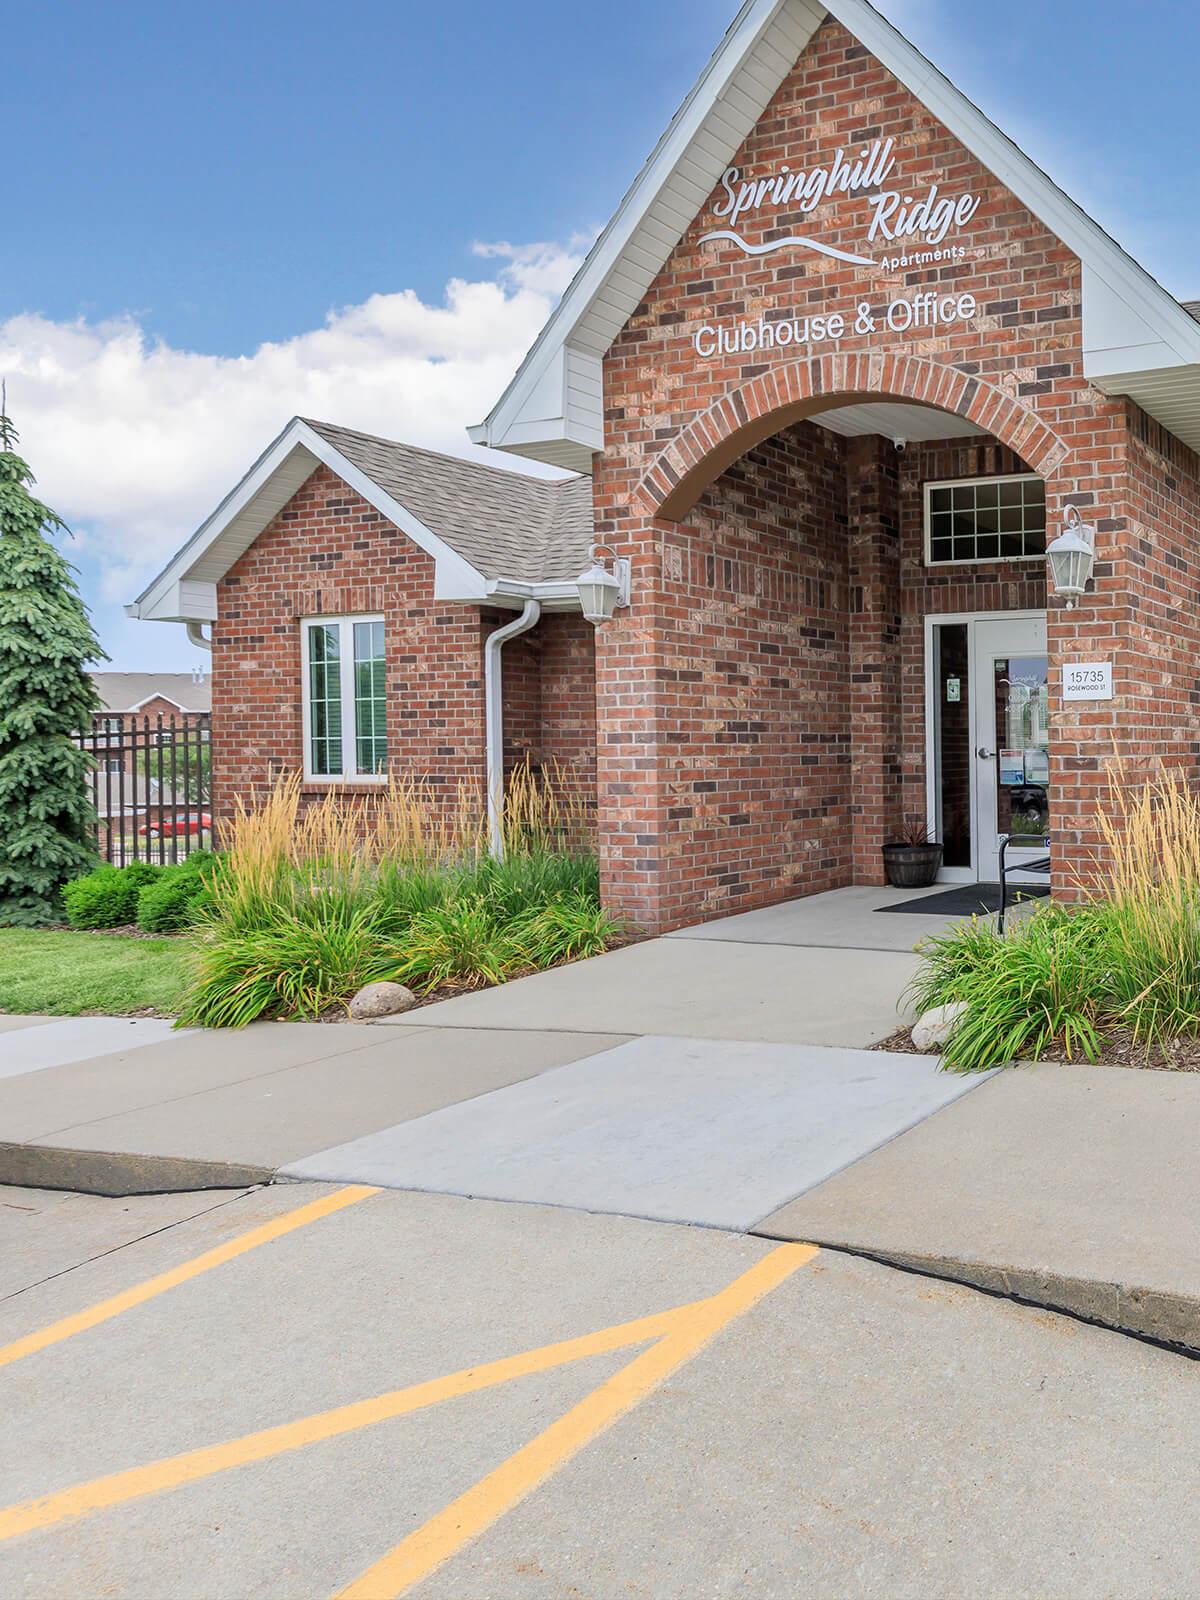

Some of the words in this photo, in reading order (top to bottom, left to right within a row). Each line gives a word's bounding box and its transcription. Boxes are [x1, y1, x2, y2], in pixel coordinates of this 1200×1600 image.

[712, 137, 896, 227] Springhill
[868, 185, 981, 245] Ridge
[880, 245, 966, 270] Apartments
[694, 313, 844, 357] Clubhouse
[854, 302, 876, 335] &
[887, 291, 976, 332] Office
[1070, 670, 1104, 682] 15735
